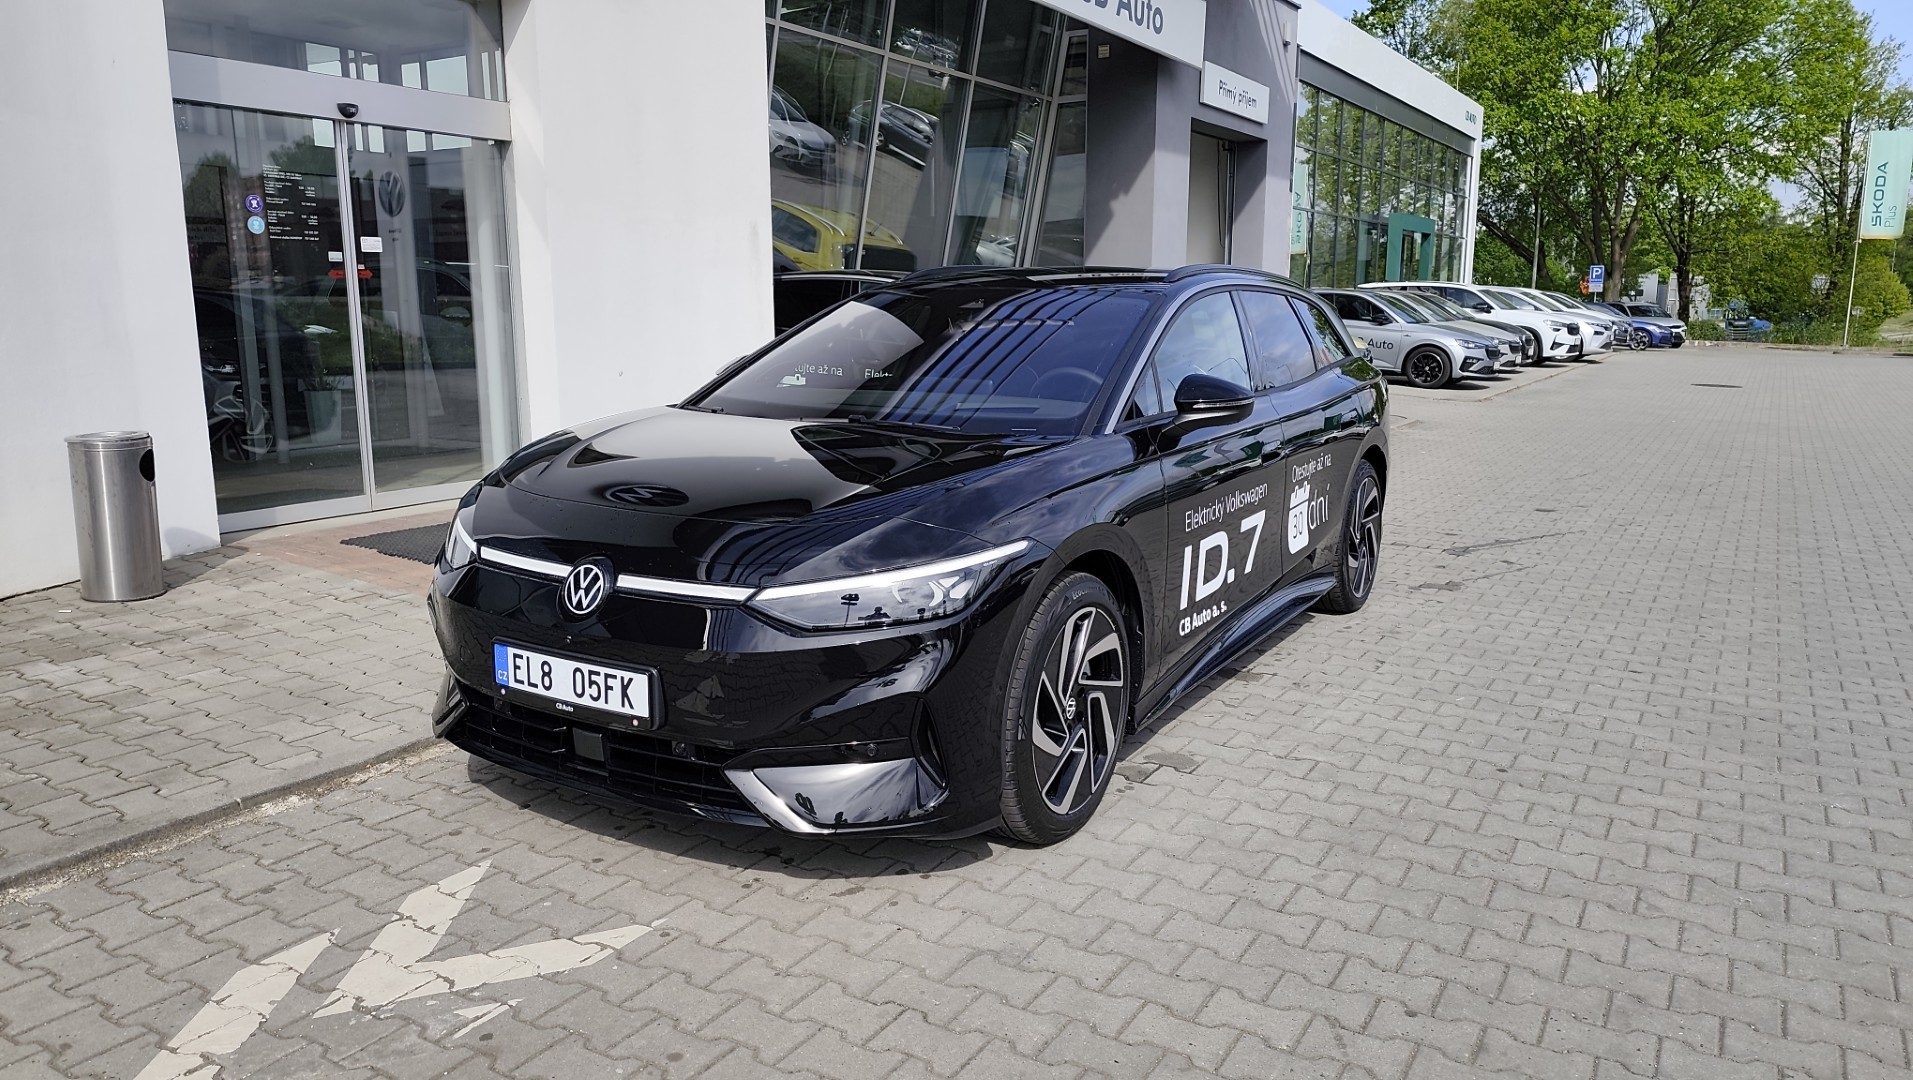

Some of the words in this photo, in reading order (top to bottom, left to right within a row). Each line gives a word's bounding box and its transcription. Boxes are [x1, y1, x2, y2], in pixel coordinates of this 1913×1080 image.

[1218, 79, 1237, 105] Přímý
[1884, 205, 1898, 228] Plus
[1592, 267, 1602, 279] P
[1367, 337, 1394, 350] Auto
[817, 364, 829, 375] až
[830, 366, 843, 377] na
[1316, 453, 1324, 472] až
[1324, 453, 1332, 468] na
[1185, 497, 1225, 532] Elektrický
[1225, 482, 1268, 513] Volkswagen
[1293, 510, 1303, 540] 30
[1308, 483, 1331, 530] dní
[1179, 616, 1191, 637] CB
[1191, 608, 1212, 631] Auto
[497, 669, 508, 681] CZ
[512, 652, 553, 692] EL8
[572, 667, 635, 711] 05FK
